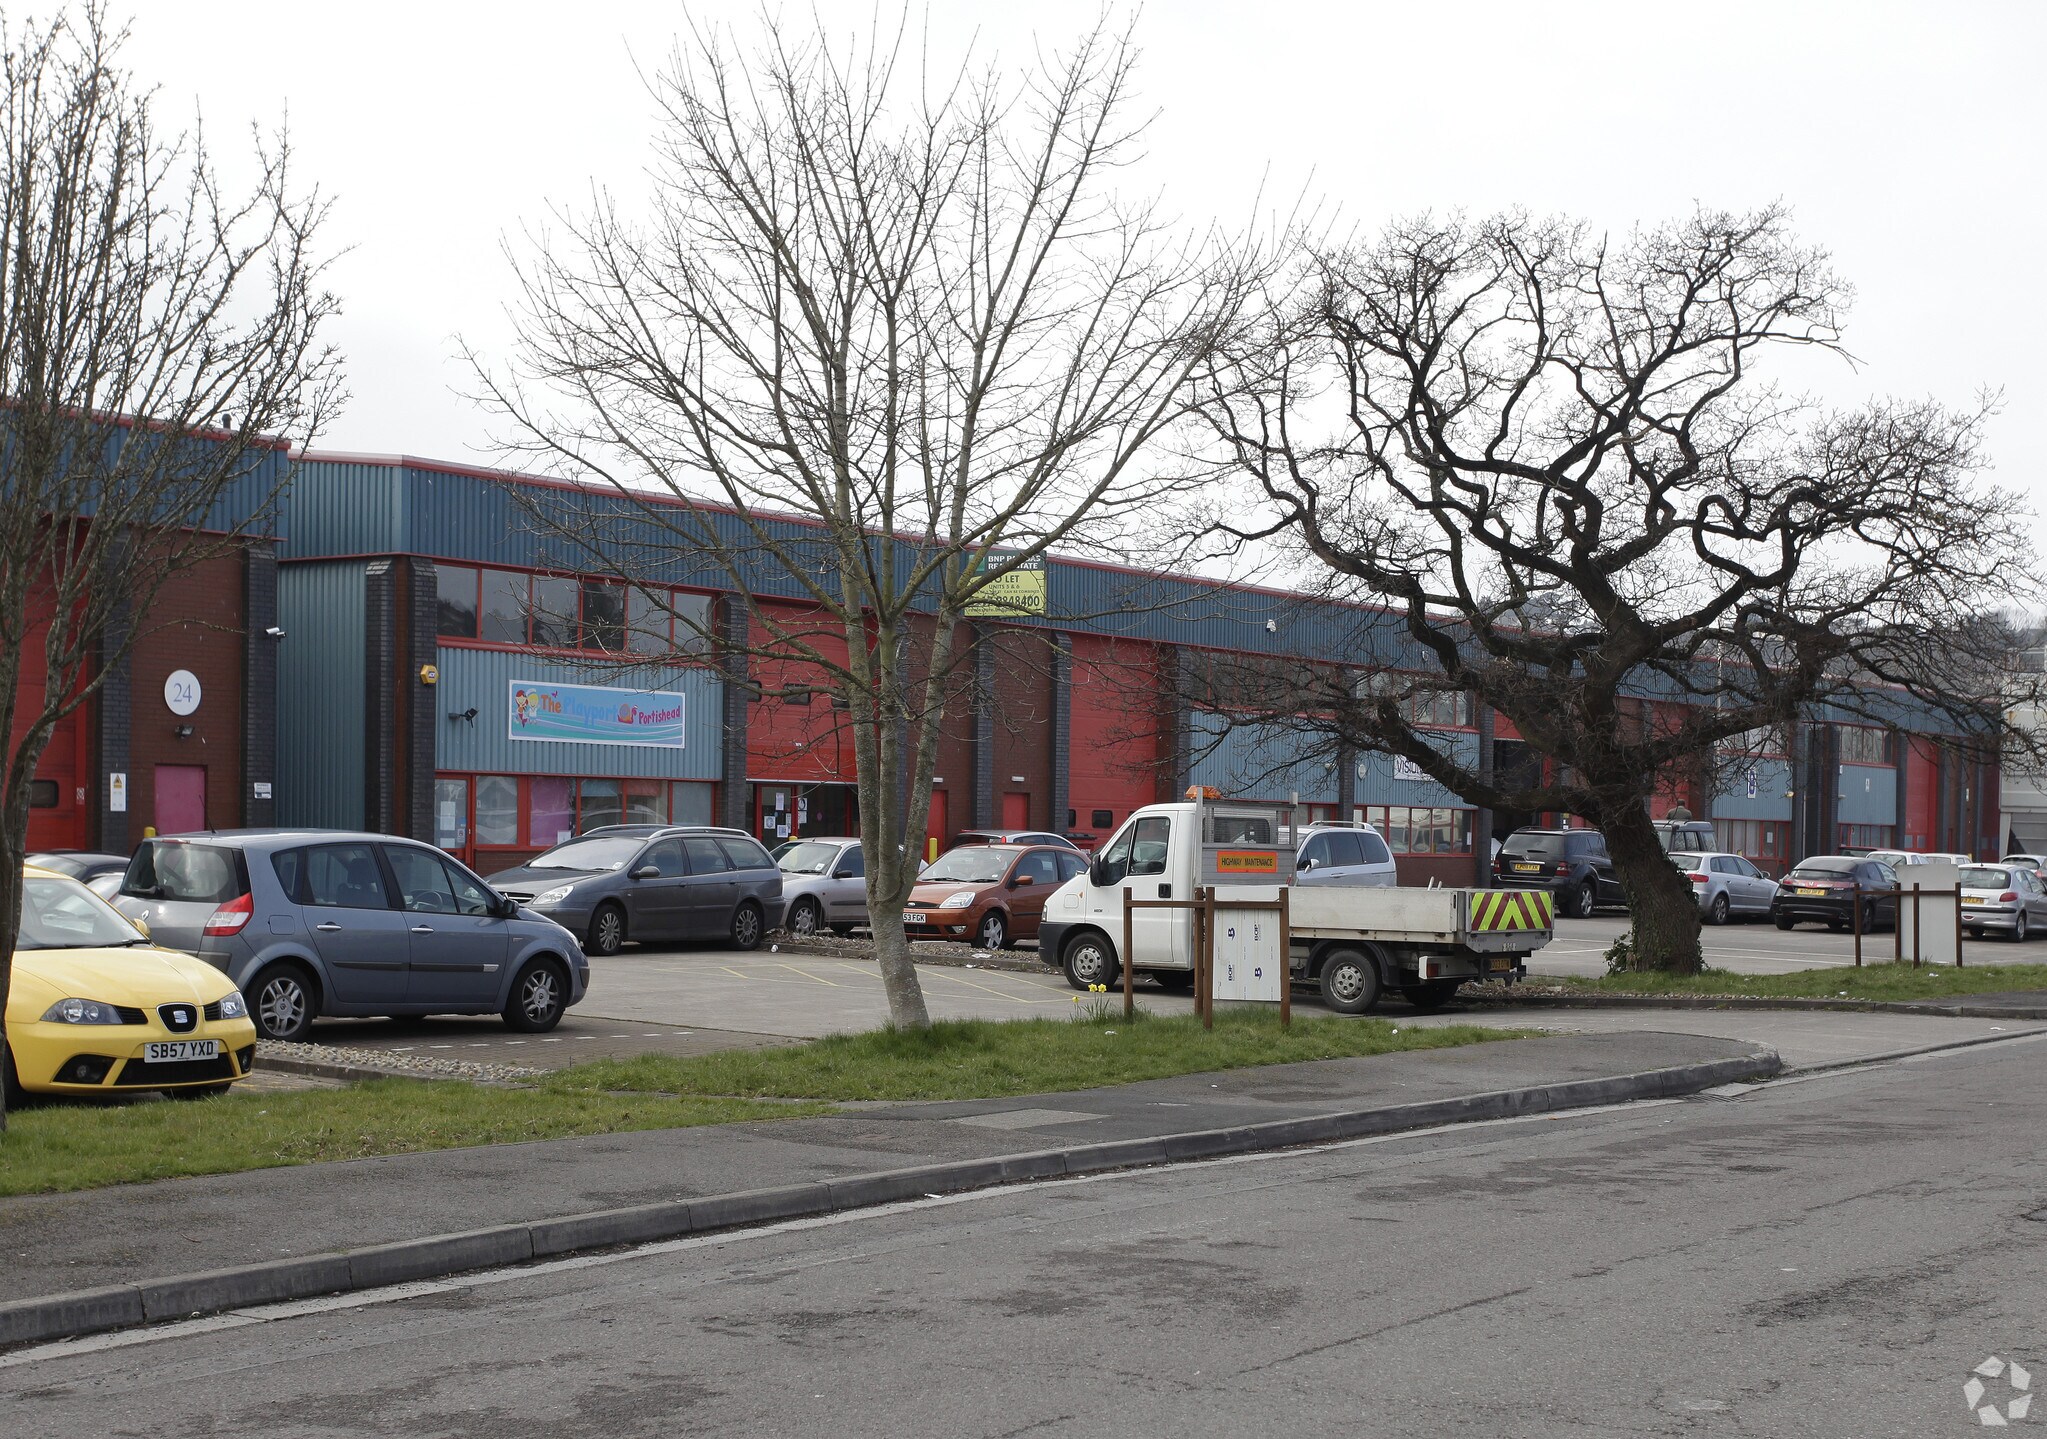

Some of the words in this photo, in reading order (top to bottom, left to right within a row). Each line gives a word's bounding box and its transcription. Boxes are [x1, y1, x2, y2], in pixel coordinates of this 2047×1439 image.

[1005, 575, 1020, 583] LET
[173, 683, 193, 703] 24
[541, 694, 562, 713] The
[563, 697, 618, 726] Playport
[638, 706, 681, 725] Portishead
[1221, 857, 1242, 867] HIGHWAY
[1244, 858, 1273, 867] MAINTENANCE
[912, 914, 924, 922] FGK
[151, 1043, 186, 1058] SB57
[190, 1041, 214, 1056] YXD
